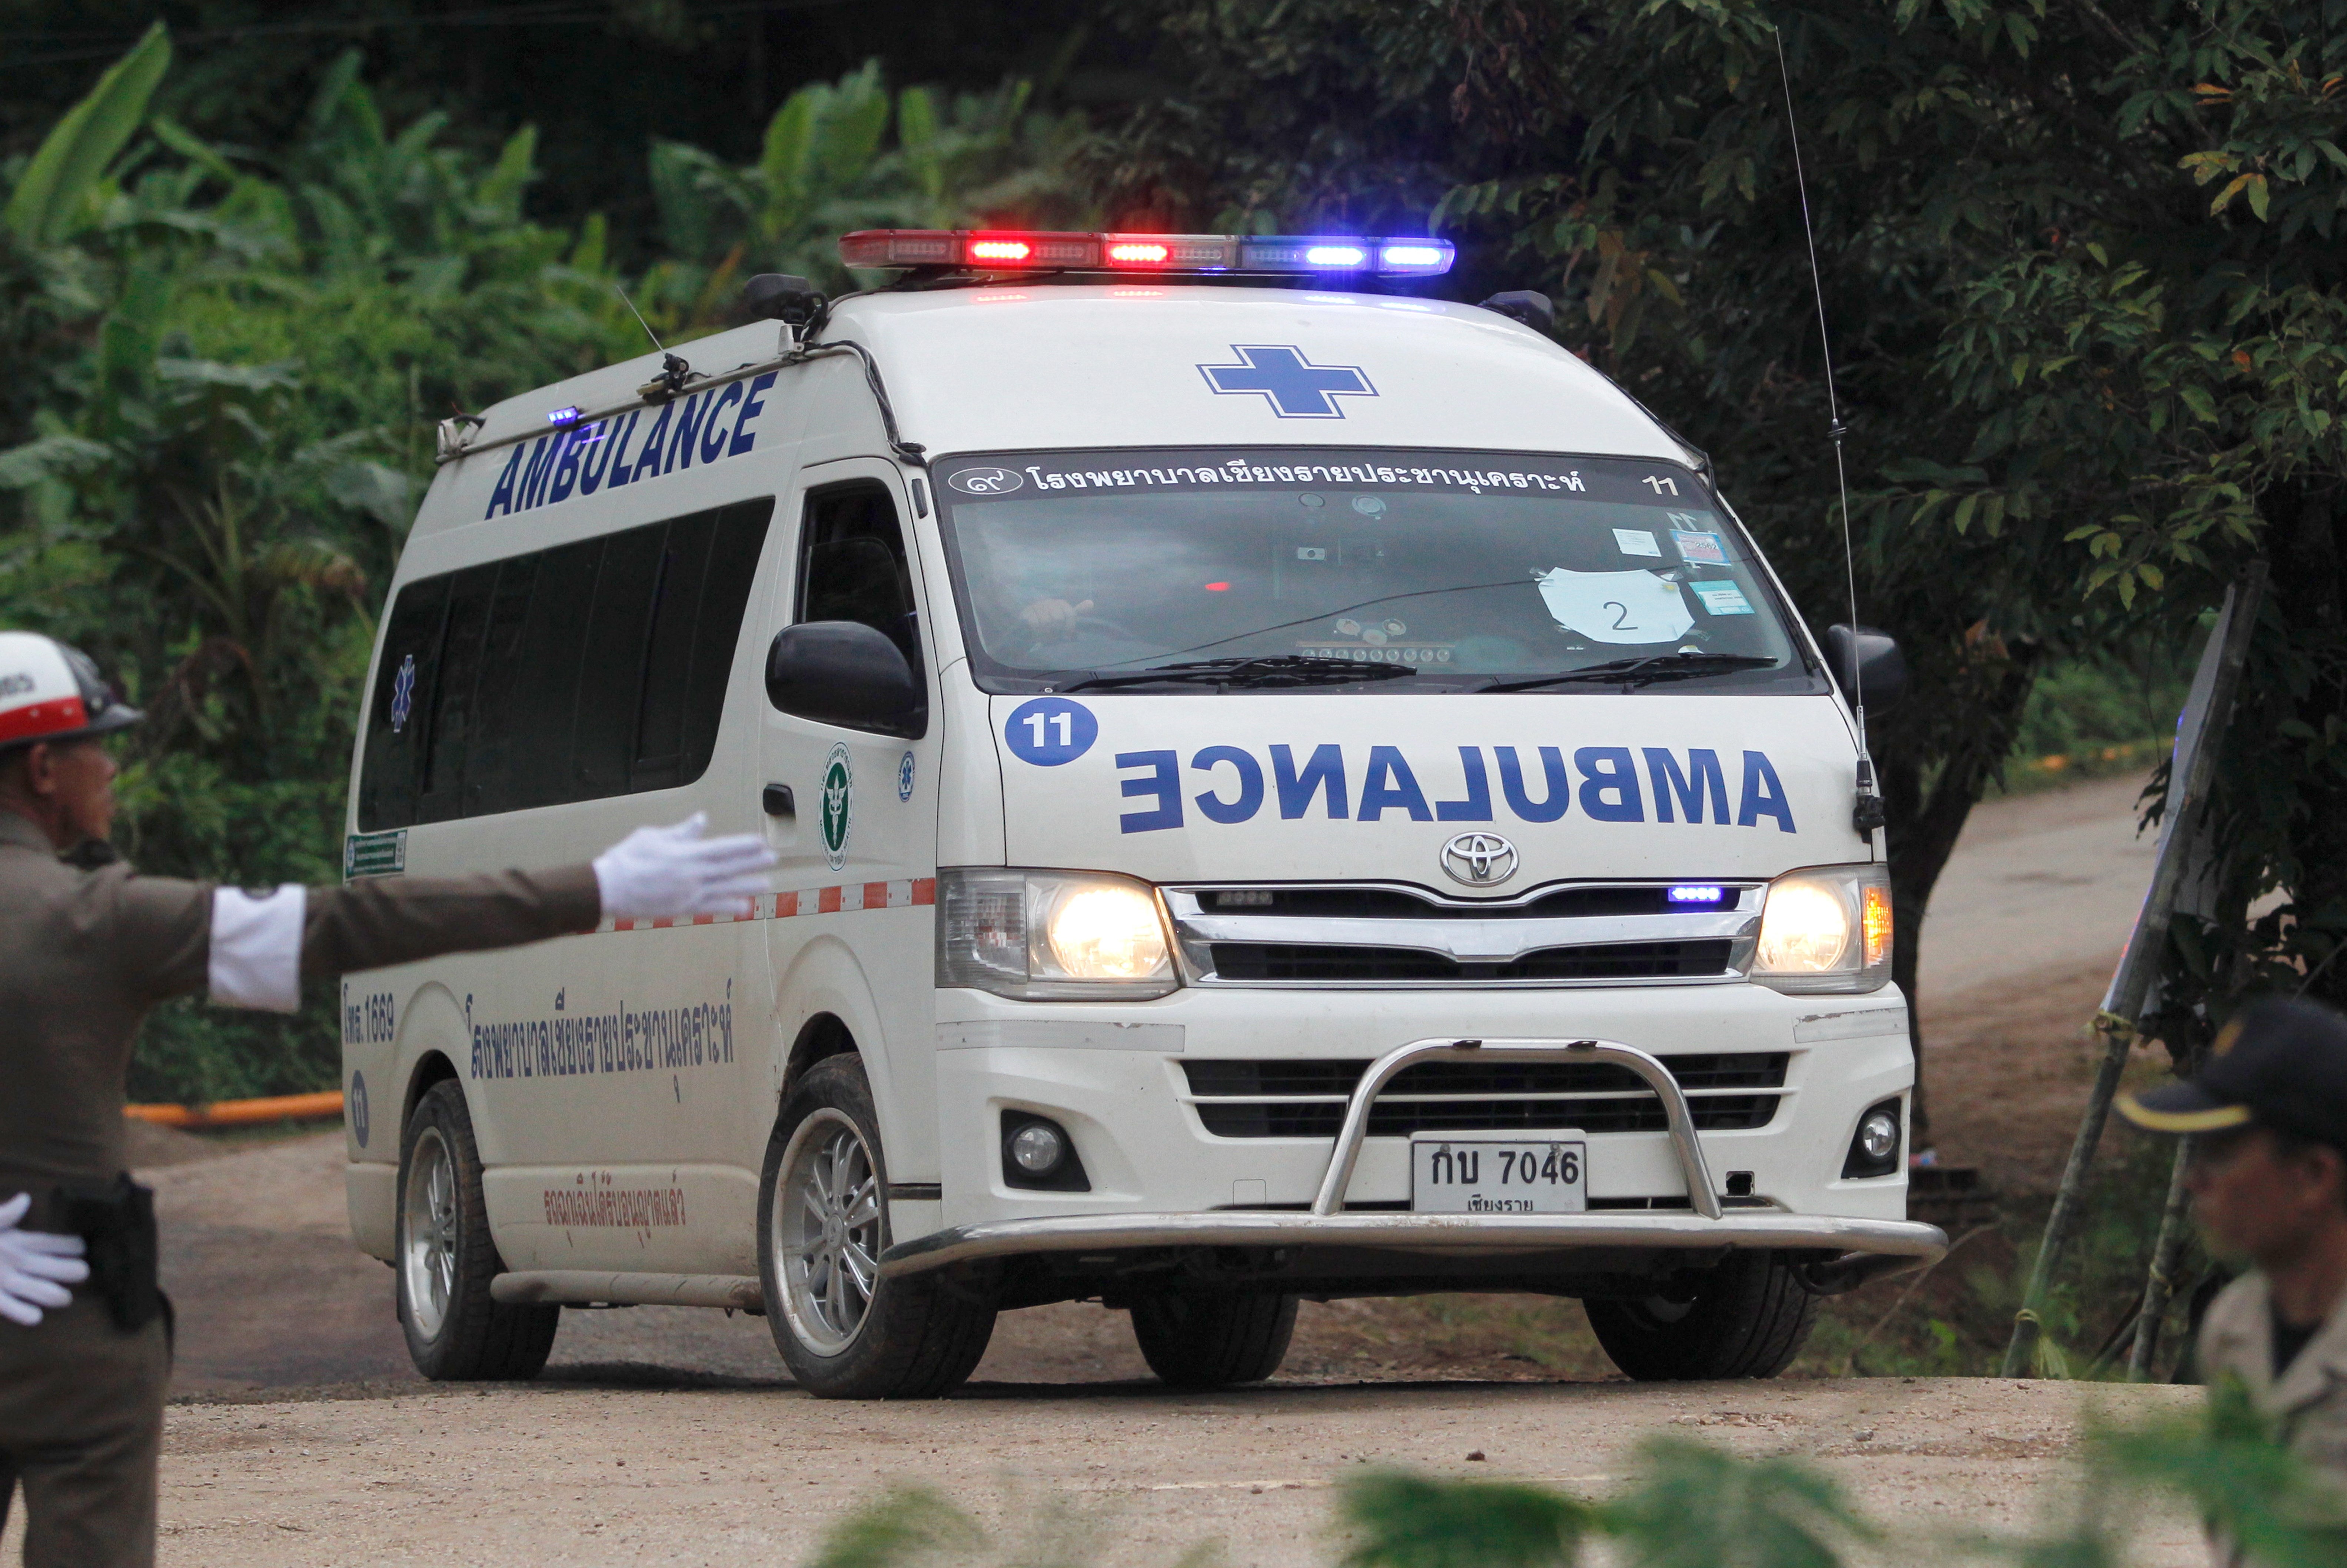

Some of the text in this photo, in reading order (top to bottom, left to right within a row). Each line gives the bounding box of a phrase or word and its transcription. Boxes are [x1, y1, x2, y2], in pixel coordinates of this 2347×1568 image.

[484, 370, 779, 520] AMBULANCE
[1025, 459, 1586, 494] โรงพยาบาลเชียงรายประชานุเคราะห์
[1642, 476, 1679, 496] 11
[1603, 601, 1638, 630] 2
[1022, 712, 1071, 747] 11
[365, 993, 394, 1042] 1669
[466, 978, 734, 1103] โรงพยาบาลเชียงรายประชานุเคราะห์
[353, 1088, 365, 1128] 11
[1432, 1151, 1578, 1184] กบ 7046
[544, 1168, 686, 1249] รถฉุกเฉินได้รับอนุญาตแล้ว
[1468, 1194, 1533, 1211] เชียงราย
